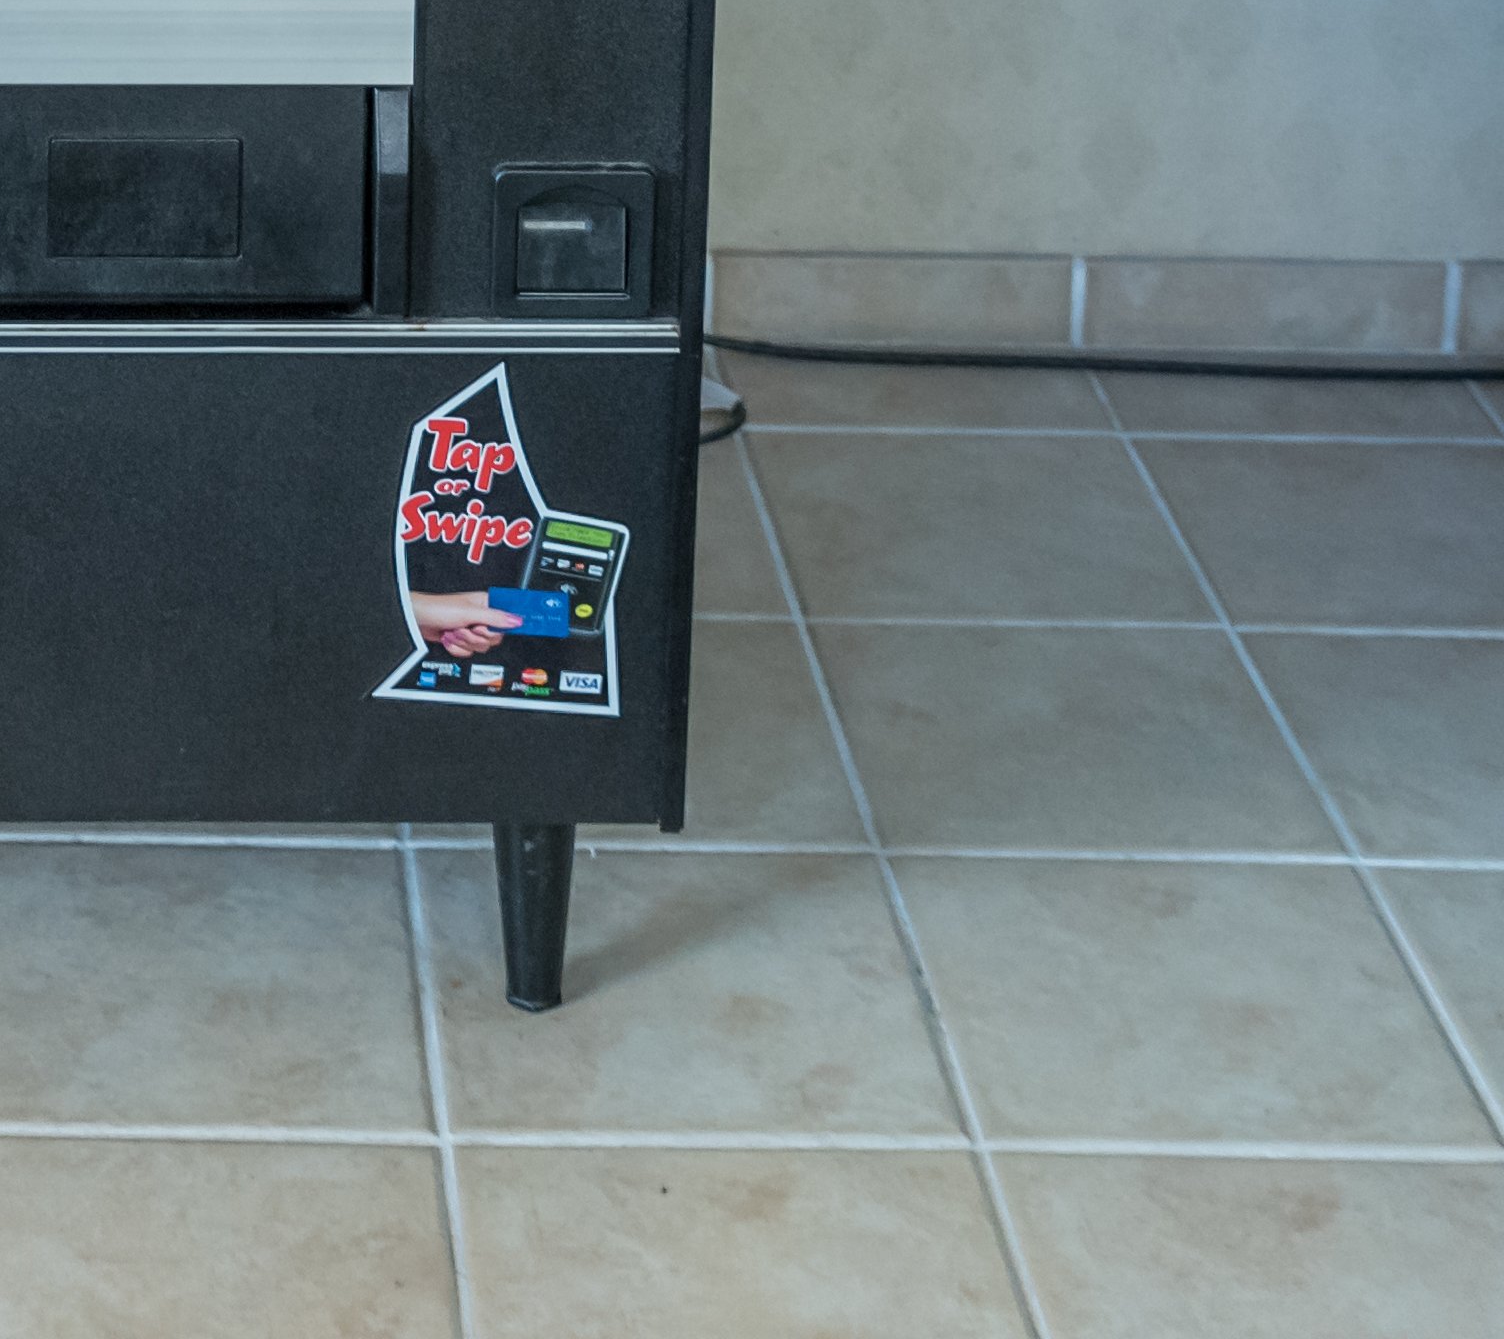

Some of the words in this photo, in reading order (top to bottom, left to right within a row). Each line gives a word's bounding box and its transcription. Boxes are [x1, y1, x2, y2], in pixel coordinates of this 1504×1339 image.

[427, 418, 517, 493] Tap
[434, 478, 471, 496] or
[399, 491, 533, 564] Swipe
[565, 676, 600, 691] VISA
